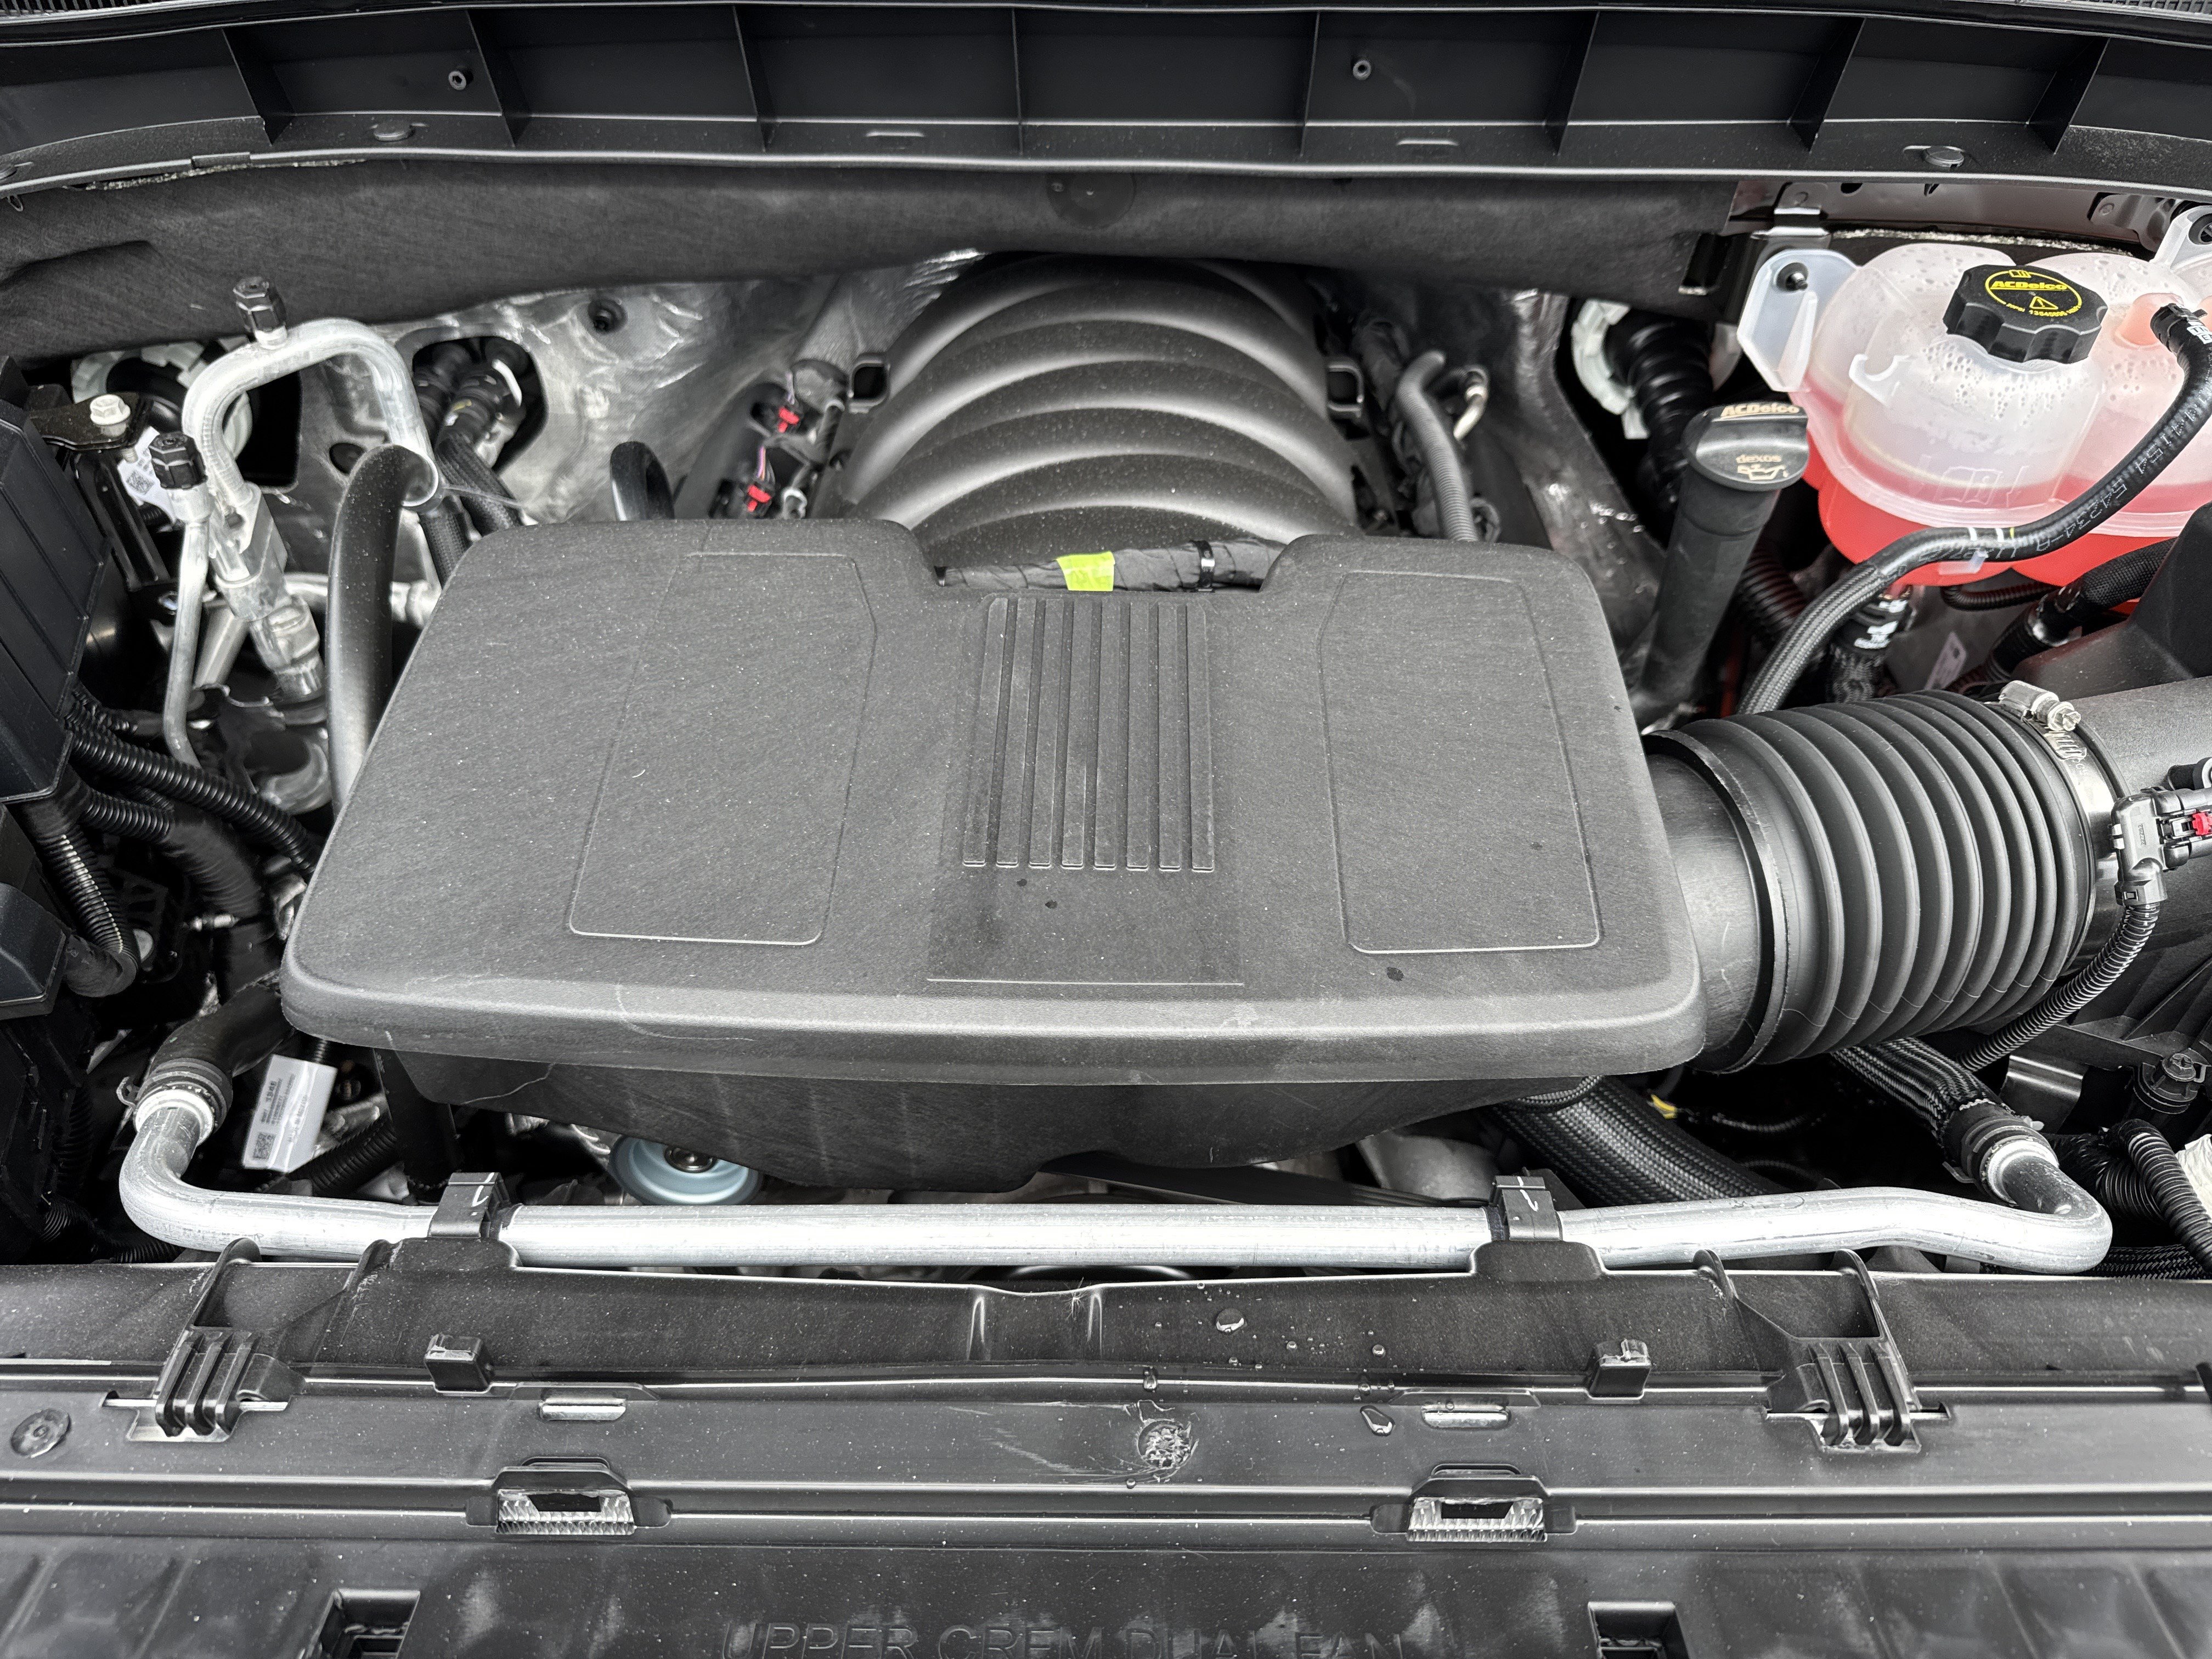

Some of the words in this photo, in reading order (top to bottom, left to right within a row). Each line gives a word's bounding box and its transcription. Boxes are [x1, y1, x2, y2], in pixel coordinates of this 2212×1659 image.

[1991, 280, 2068, 290] ACDelco
[1720, 402, 1799, 417] ACDelco
[1736, 454, 1781, 464] dexos
[723, 1622, 917, 1659] UPPER
